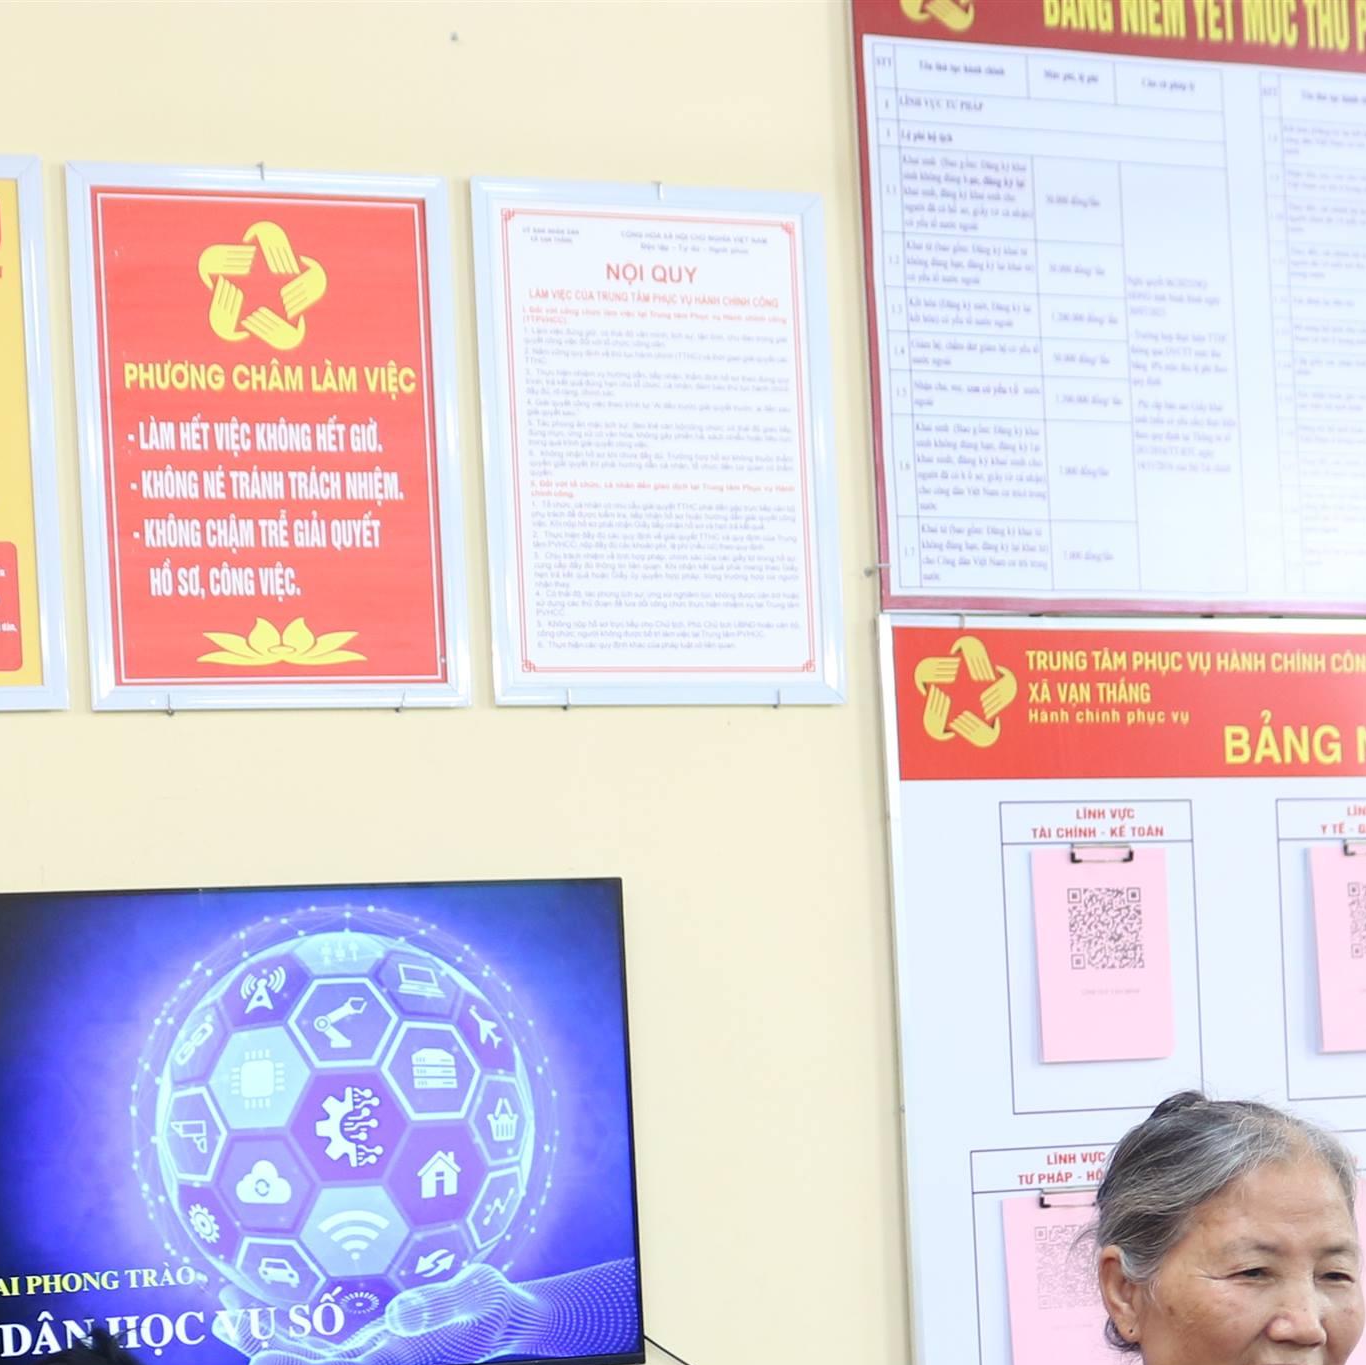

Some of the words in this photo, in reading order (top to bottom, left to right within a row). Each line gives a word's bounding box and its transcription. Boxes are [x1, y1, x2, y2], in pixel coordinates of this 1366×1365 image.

[606, 262, 644, 286] NỘI
[651, 264, 697, 284] QUY
[124, 360, 225, 391] PHƯƠNG
[232, 360, 304, 392] CHÂM
[310, 361, 358, 393] LÀM
[363, 361, 416, 401] VIỆC
[138, 415, 176, 451] LÀM
[179, 413, 210, 451] HẾT
[213, 416, 252, 458] VIỆC
[255, 416, 313, 452] KHÔNG
[315, 415, 346, 453] HẾT
[349, 417, 383, 453] GIỜ.
[141, 464, 200, 500] KHÔNG
[202, 464, 227, 500] NÉ
[229, 464, 285, 500] TRÁNH
[287, 465, 342, 500] TRÁCH
[344, 465, 404, 507] NHIỆM.
[144, 512, 203, 548] KHÔNG
[205, 513, 256, 554] CHẬM
[258, 509, 290, 548] TRỄ
[293, 510, 327, 548] GIẢI
[330, 510, 381, 551] QUYẾT
[149, 558, 174, 597] HỒ
[177, 564, 206, 599] SƠ,
[209, 561, 256, 597] CÔNG
[258, 561, 301, 602] VIỆC.
[1026, 650, 1088, 672] TRUNG
[1092, 648, 1128, 671] TÂM
[1130, 651, 1183, 675] PHỤC
[1186, 651, 1212, 675] VỤ
[1216, 647, 1266, 673] HÀNH
[1270, 647, 1327, 673] CHÍNH
[1028, 679, 1052, 703] XÃ
[1057, 682, 1091, 707] VẠN
[1096, 679, 1151, 704] THẮNG
[1028, 708, 1071, 724] Hành
[1075, 707, 1121, 724] chính
[1126, 707, 1166, 726] phục
[1170, 710, 1190, 726] vụ
[1222, 710, 1343, 766] BẢNG
[1031, 825, 1052, 839] TÀI
[1056, 824, 1097, 839] CHÍNH
[1109, 824, 1126, 838] KẾ
[1130, 823, 1164, 839] TOÁN
[1075, 807, 1106, 820] LĨNH
[1109, 807, 1135, 821] VỰC
[26, 1271, 119, 1296] PHONG
[125, 1263, 196, 1291] TRÀO
[105, 1311, 205, 1356] HỌC
[216, 1307, 276, 1349] VỤ
[289, 1286, 344, 1338] SỐ
